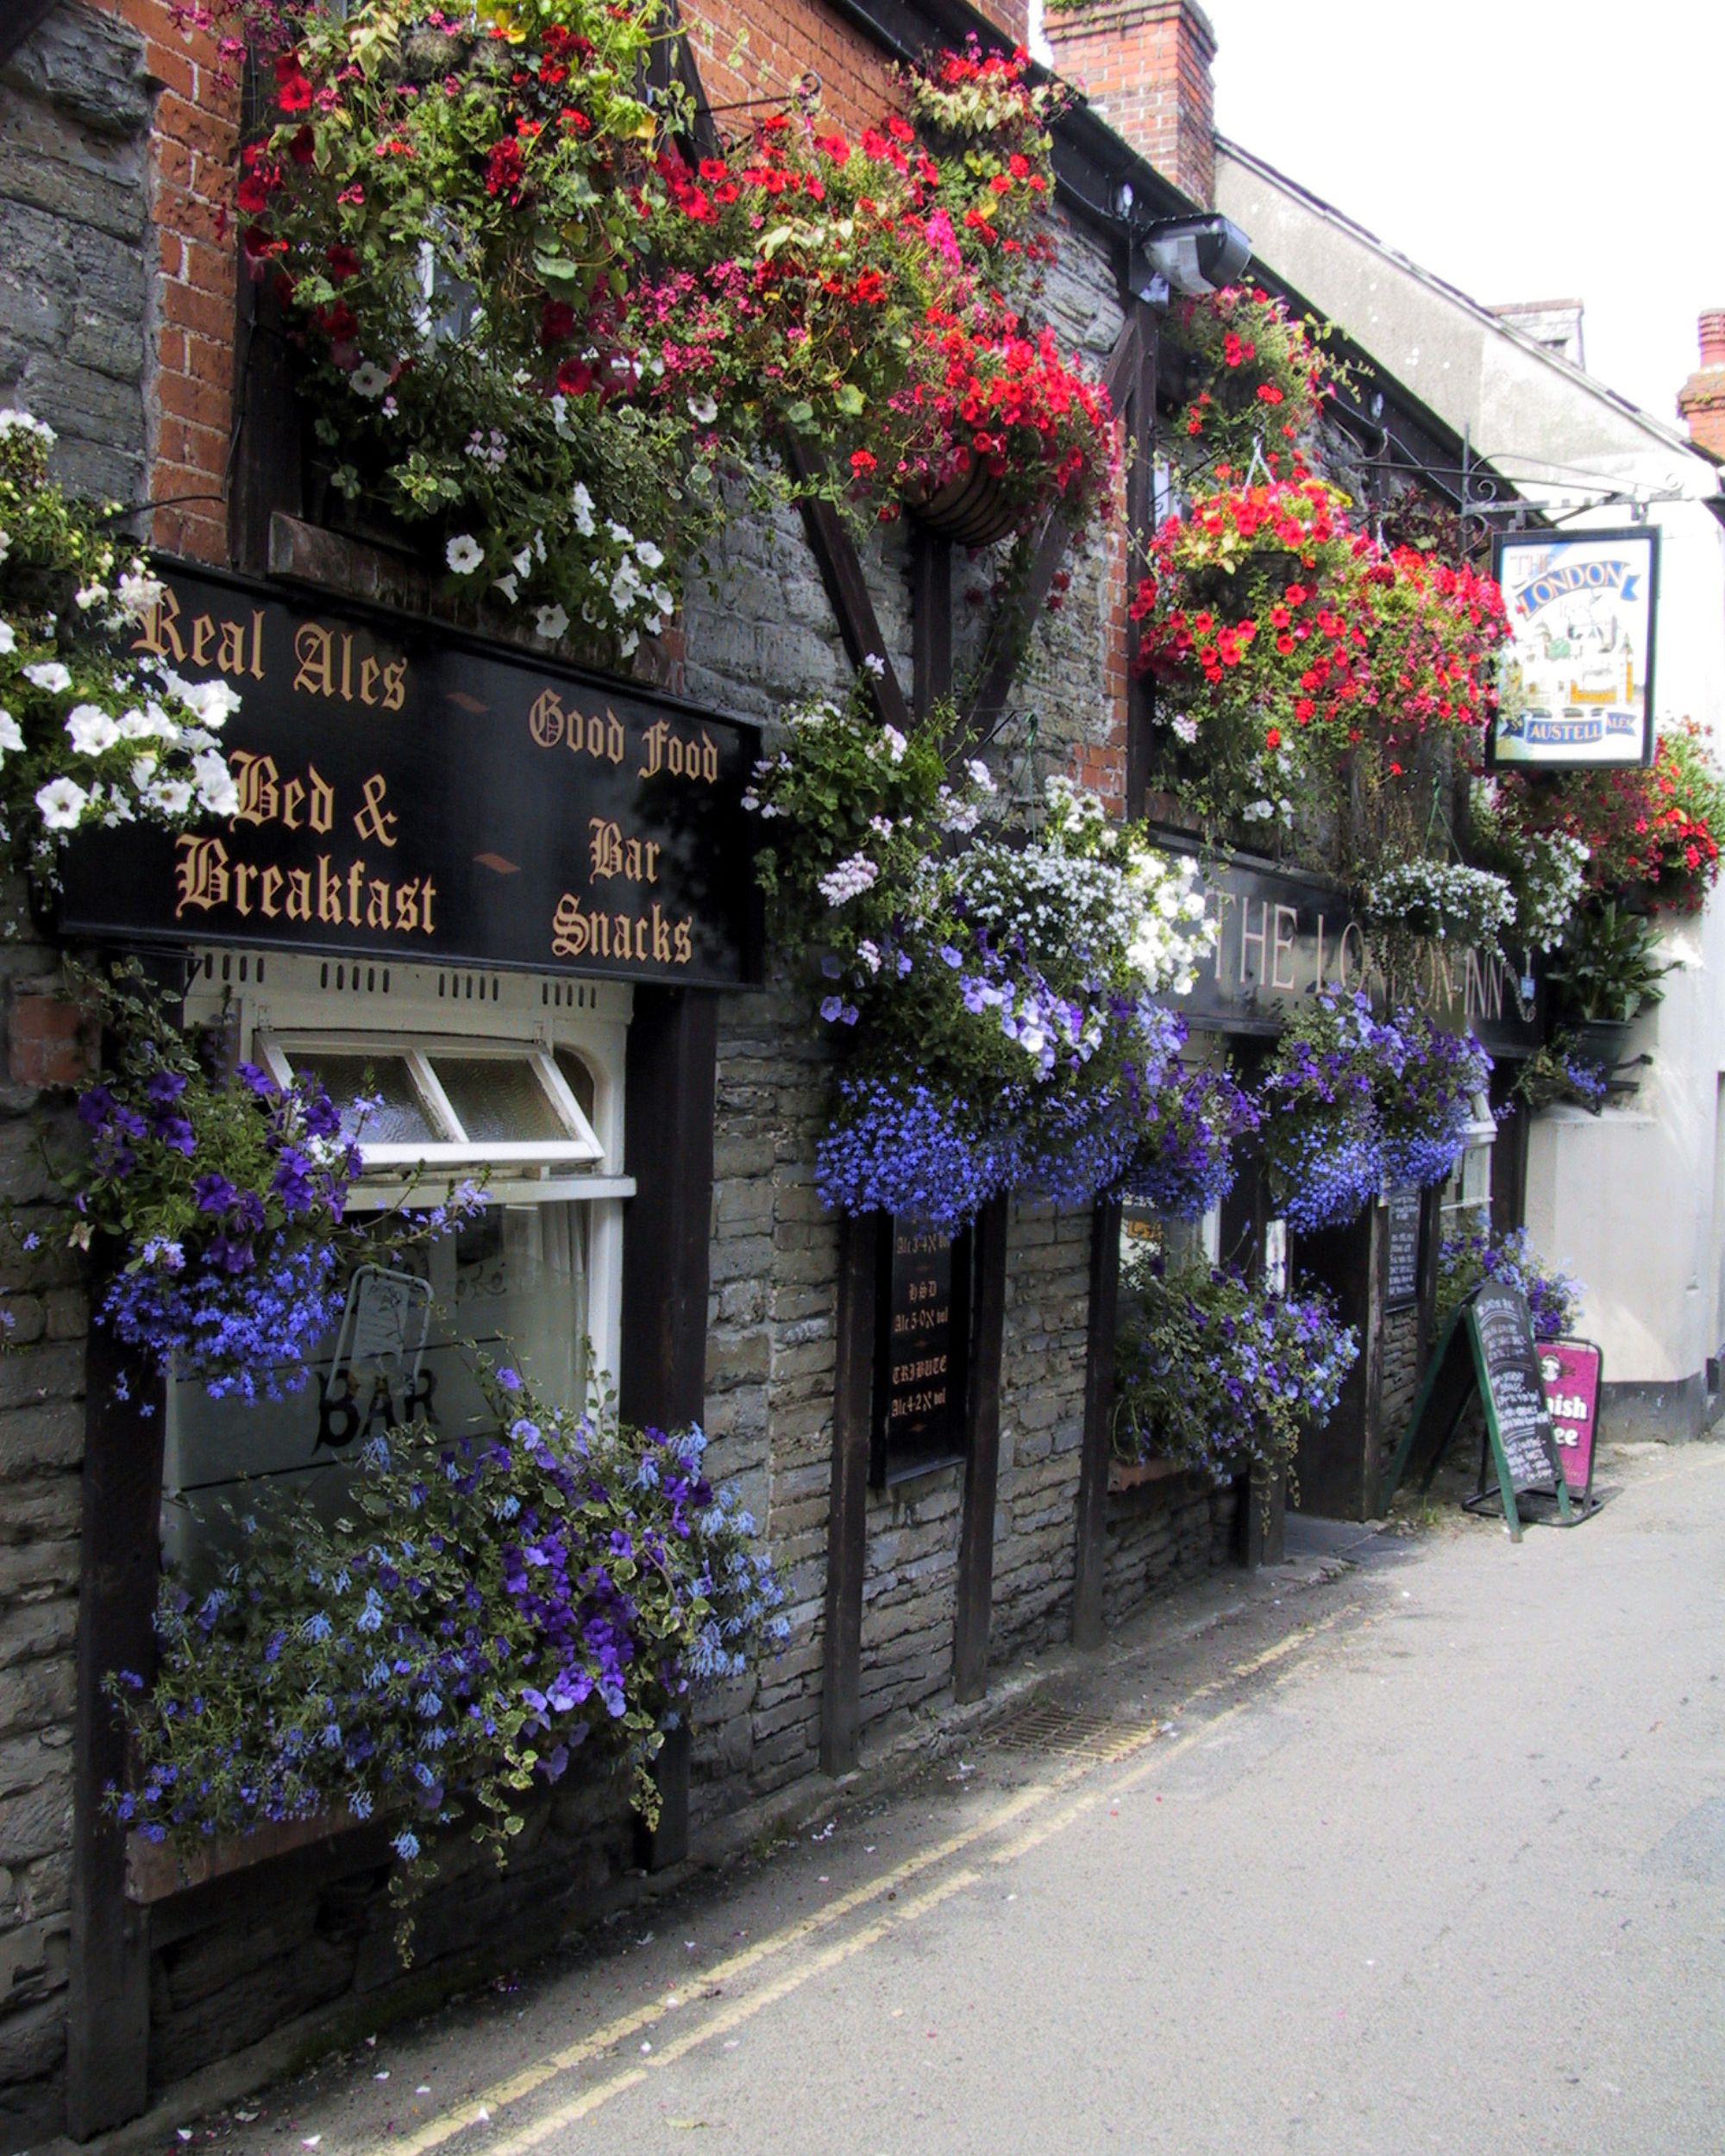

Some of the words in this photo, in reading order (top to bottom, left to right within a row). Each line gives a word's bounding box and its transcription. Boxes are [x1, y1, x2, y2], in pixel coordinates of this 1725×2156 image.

[1519, 561, 1627, 618] LONDON
[131, 587, 265, 680] Real
[293, 621, 408, 711] Ales
[529, 687, 625, 765] Good
[637, 717, 718, 785] Food
[1530, 723, 1600, 741] AUSTELL
[229, 749, 335, 834] Bed
[354, 773, 398, 847] &
[175, 833, 437, 934] Breakfast
[588, 817, 661, 886] Bar
[551, 892, 693, 964] Snacks
[1205, 887, 1297, 992] THE
[312, 1368, 440, 1456] BAR
